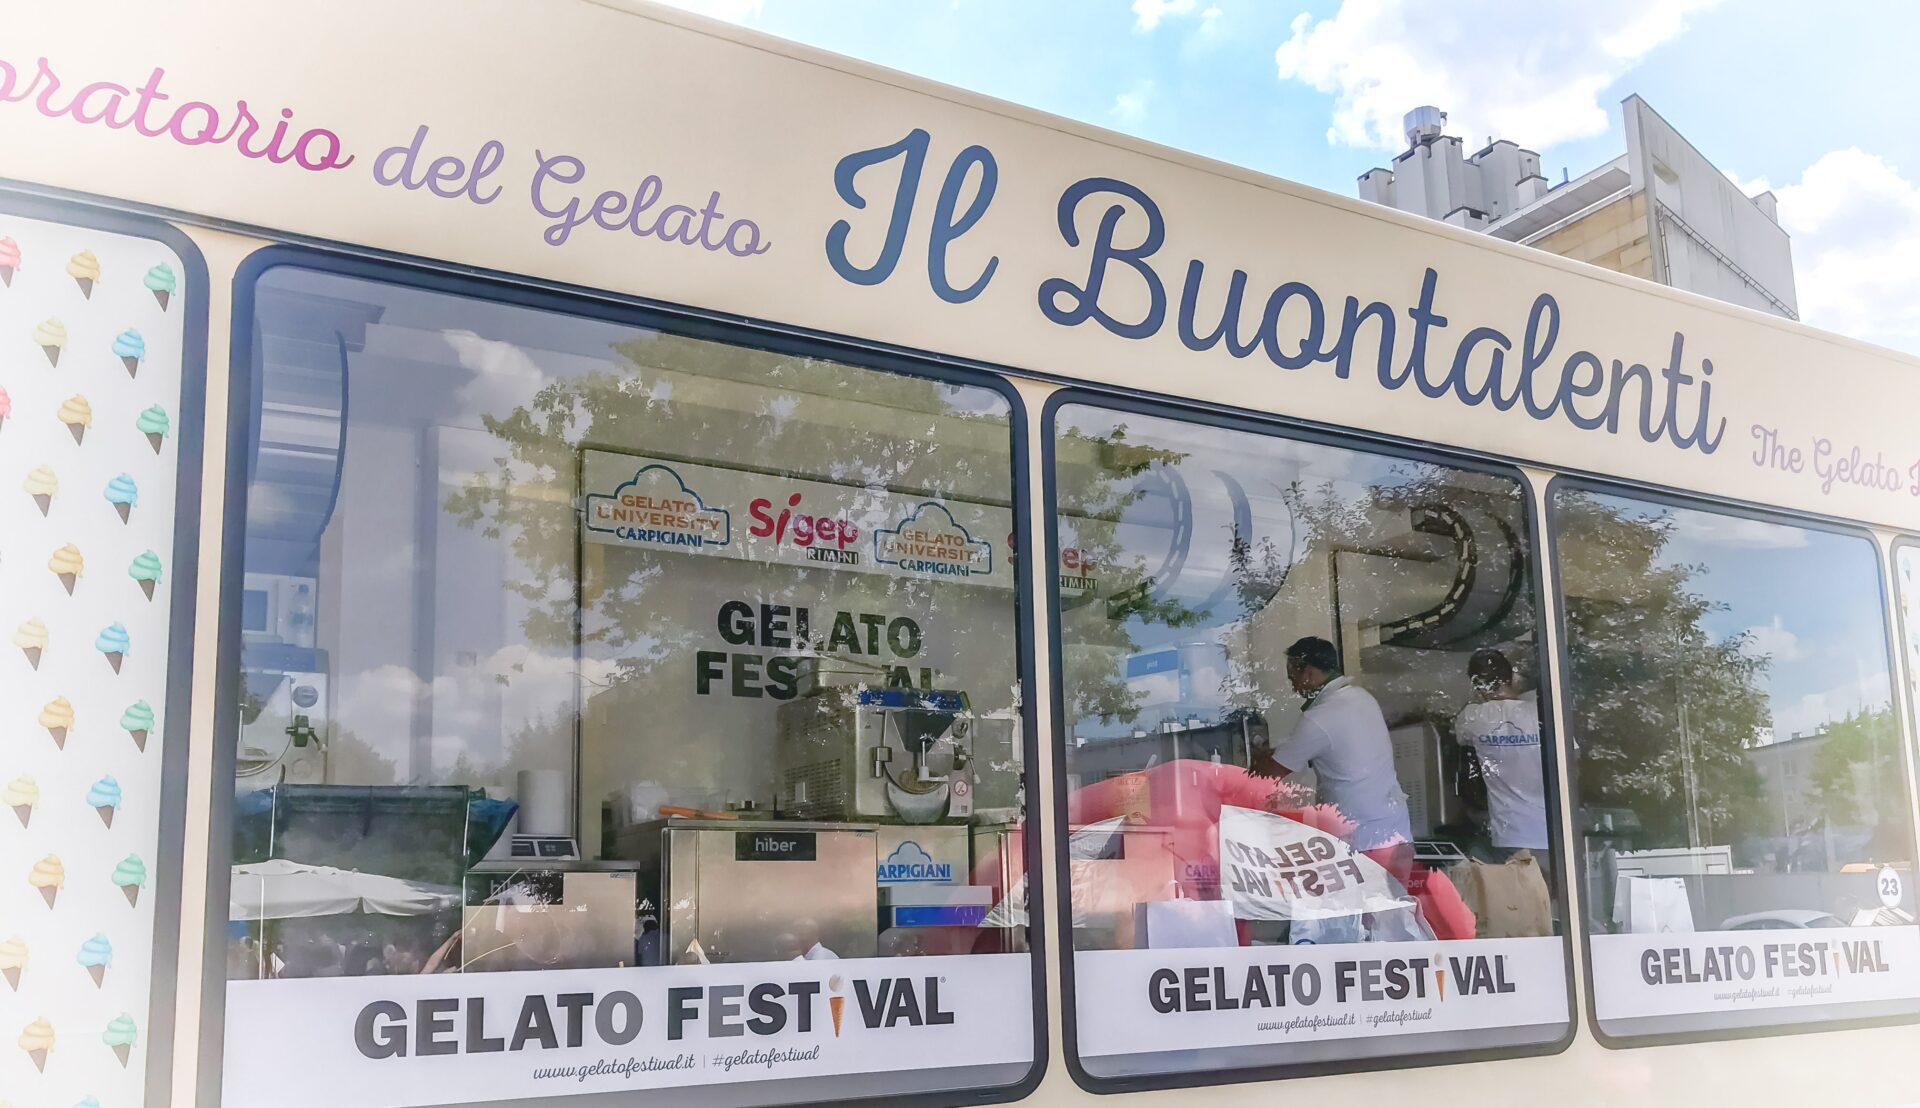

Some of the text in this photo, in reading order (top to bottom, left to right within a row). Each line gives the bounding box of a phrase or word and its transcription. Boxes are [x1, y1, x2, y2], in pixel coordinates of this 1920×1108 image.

[373, 125, 504, 205] del
[530, 148, 772, 258] Gelato
[825, 128, 1726, 454] Il Buontalenti
[1751, 424, 1804, 473] The
[1812, 436, 1903, 495] Gelato
[621, 494, 697, 514] GELATO
[597, 505, 720, 531] UNIVERSITY
[750, 493, 858, 549] Sigep
[903, 529, 964, 547] GELATO
[807, 547, 858, 564] RIMINI
[900, 559, 969, 577] CARPIGIANI
[717, 600, 922, 659] GELATO
[1479, 733, 1539, 745] CARPIGIANI
[756, 838, 797, 852] hiber
[878, 863, 951, 879] ARPIGIANI
[1881, 878, 1898, 896] 23
[1640, 945, 1756, 986] GELATO
[1148, 963, 1321, 1014] GELATO
[354, 989, 644, 1060] GELATO
[1257, 1008, 1432, 1034] www.gelatofestival.it #gelatofestival
[533, 1045, 820, 1082] www.gelatofestival.it #gelatofestival
